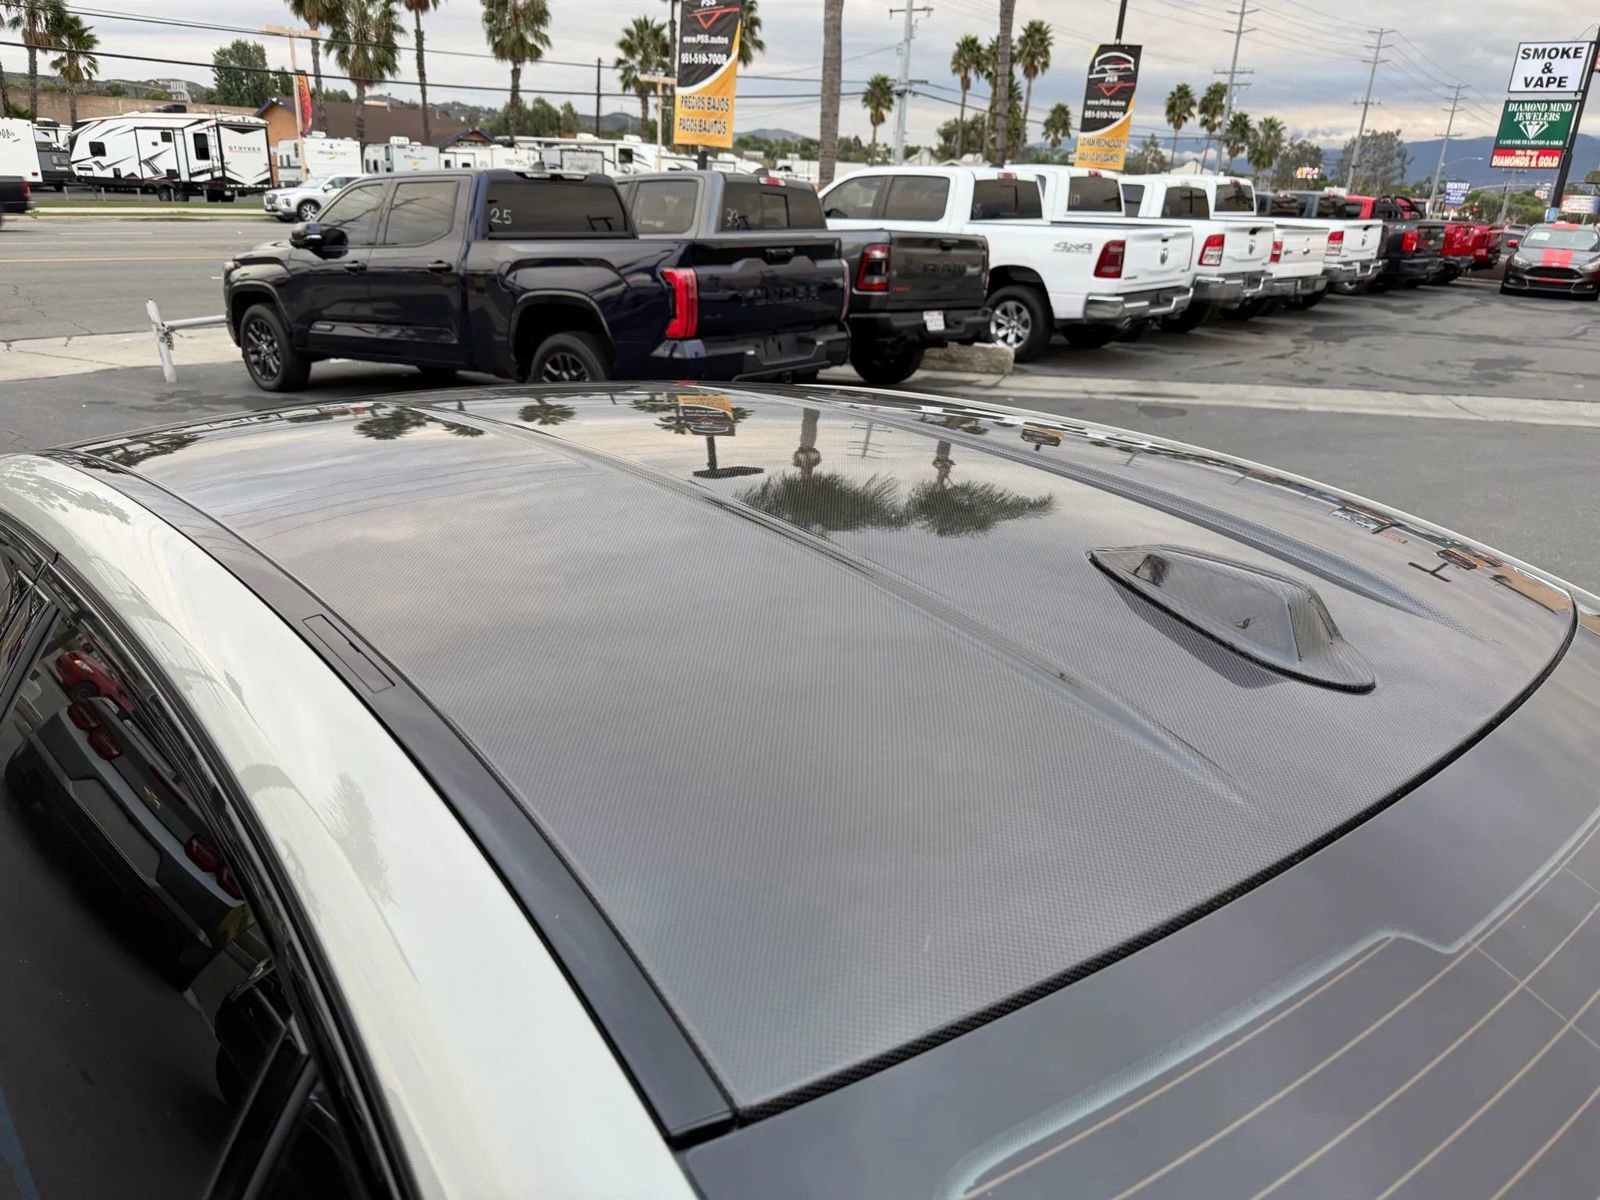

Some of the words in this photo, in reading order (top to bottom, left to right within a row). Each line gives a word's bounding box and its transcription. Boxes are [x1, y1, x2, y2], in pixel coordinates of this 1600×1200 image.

[1520, 46, 1585, 60] SMOKE
[1541, 61, 1554, 74] &
[1523, 76, 1569, 89] VAPE
[1507, 102, 1549, 112] DIAMOND
[1549, 102, 1572, 112] MIND
[1513, 111, 1561, 122] JEWELERS
[1491, 155, 1530, 167] DIAMONDS
[1537, 156, 1560, 168] GOLD
[490, 207, 513, 225] 25
